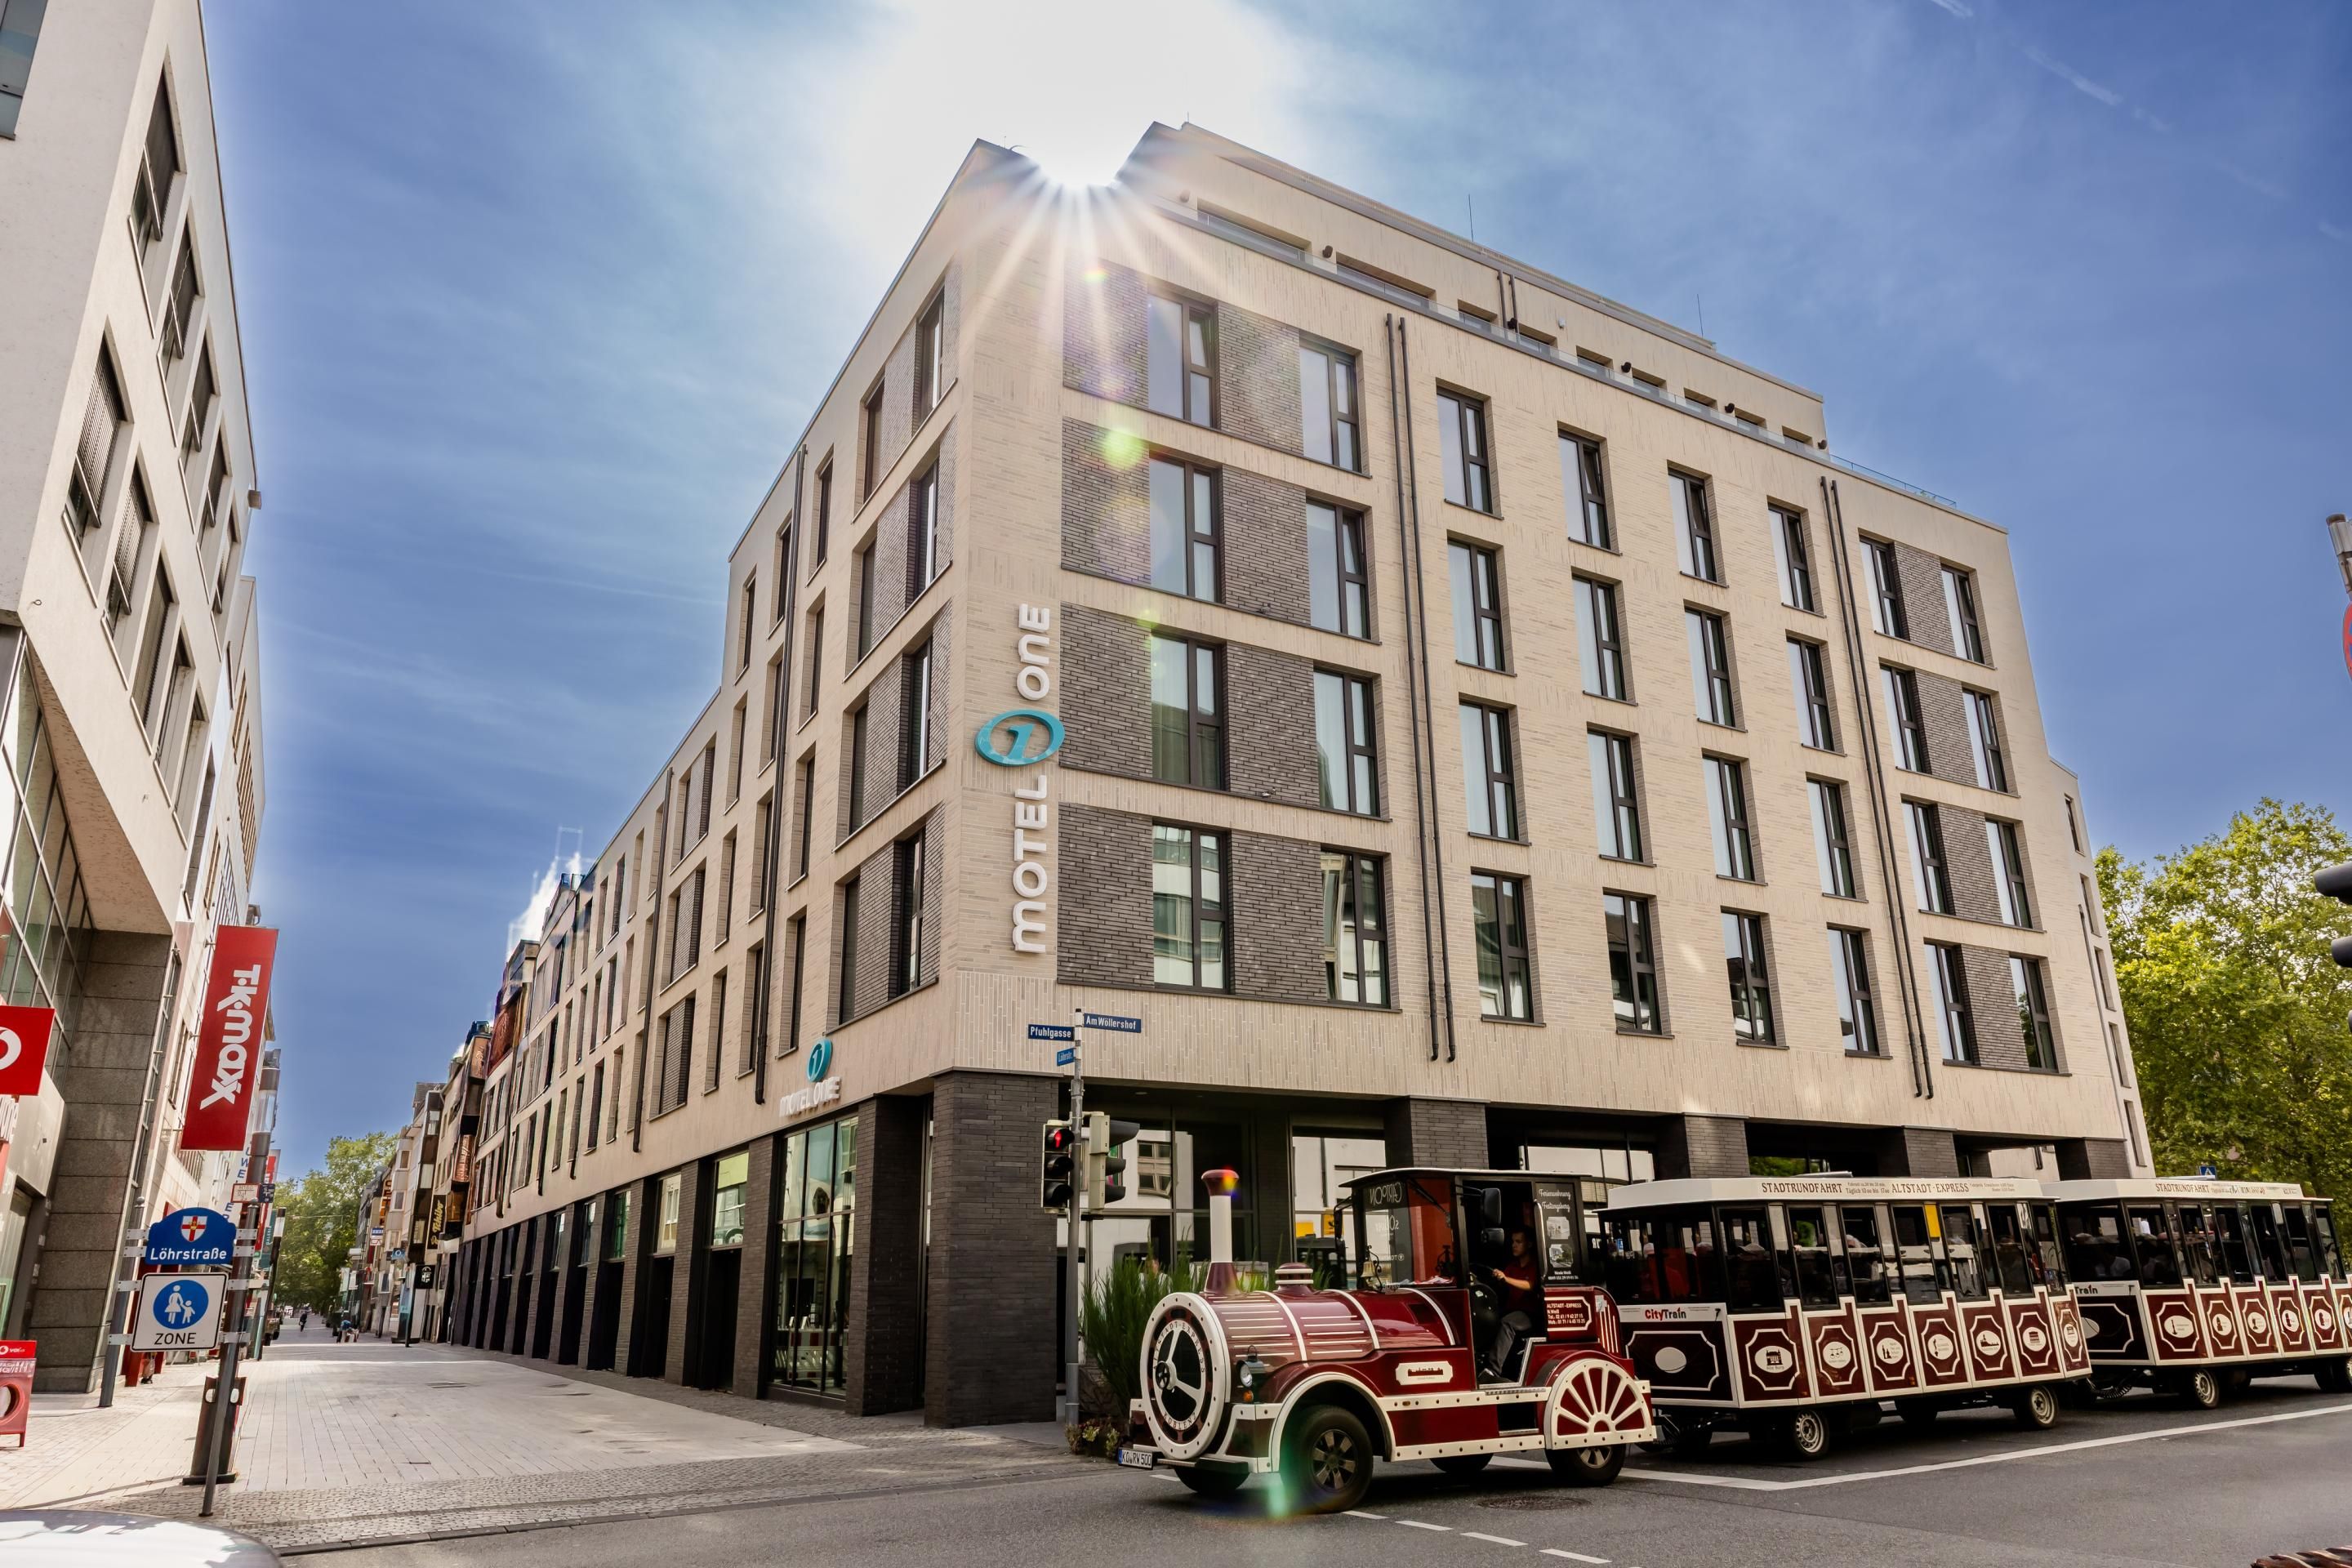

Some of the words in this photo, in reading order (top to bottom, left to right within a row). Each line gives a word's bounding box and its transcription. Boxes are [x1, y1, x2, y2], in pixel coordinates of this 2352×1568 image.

[1016, 603, 1050, 701] ONE
[1012, 774, 1047, 954] MOTEL
[1085, 1015, 1098, 1026] Am
[1098, 1017, 1137, 1030] Wöllershof
[1030, 1026, 1071, 1039] Pfuhlgasse
[1762, 1183, 1842, 1193] STADTRUNDFAHRT
[150, 1248, 227, 1260] Löhrstraße
[1645, 1307, 1686, 1321] CityTrain
[154, 1332, 197, 1345] ZONE
[1163, 1412, 1197, 1430] KOBLENZ
